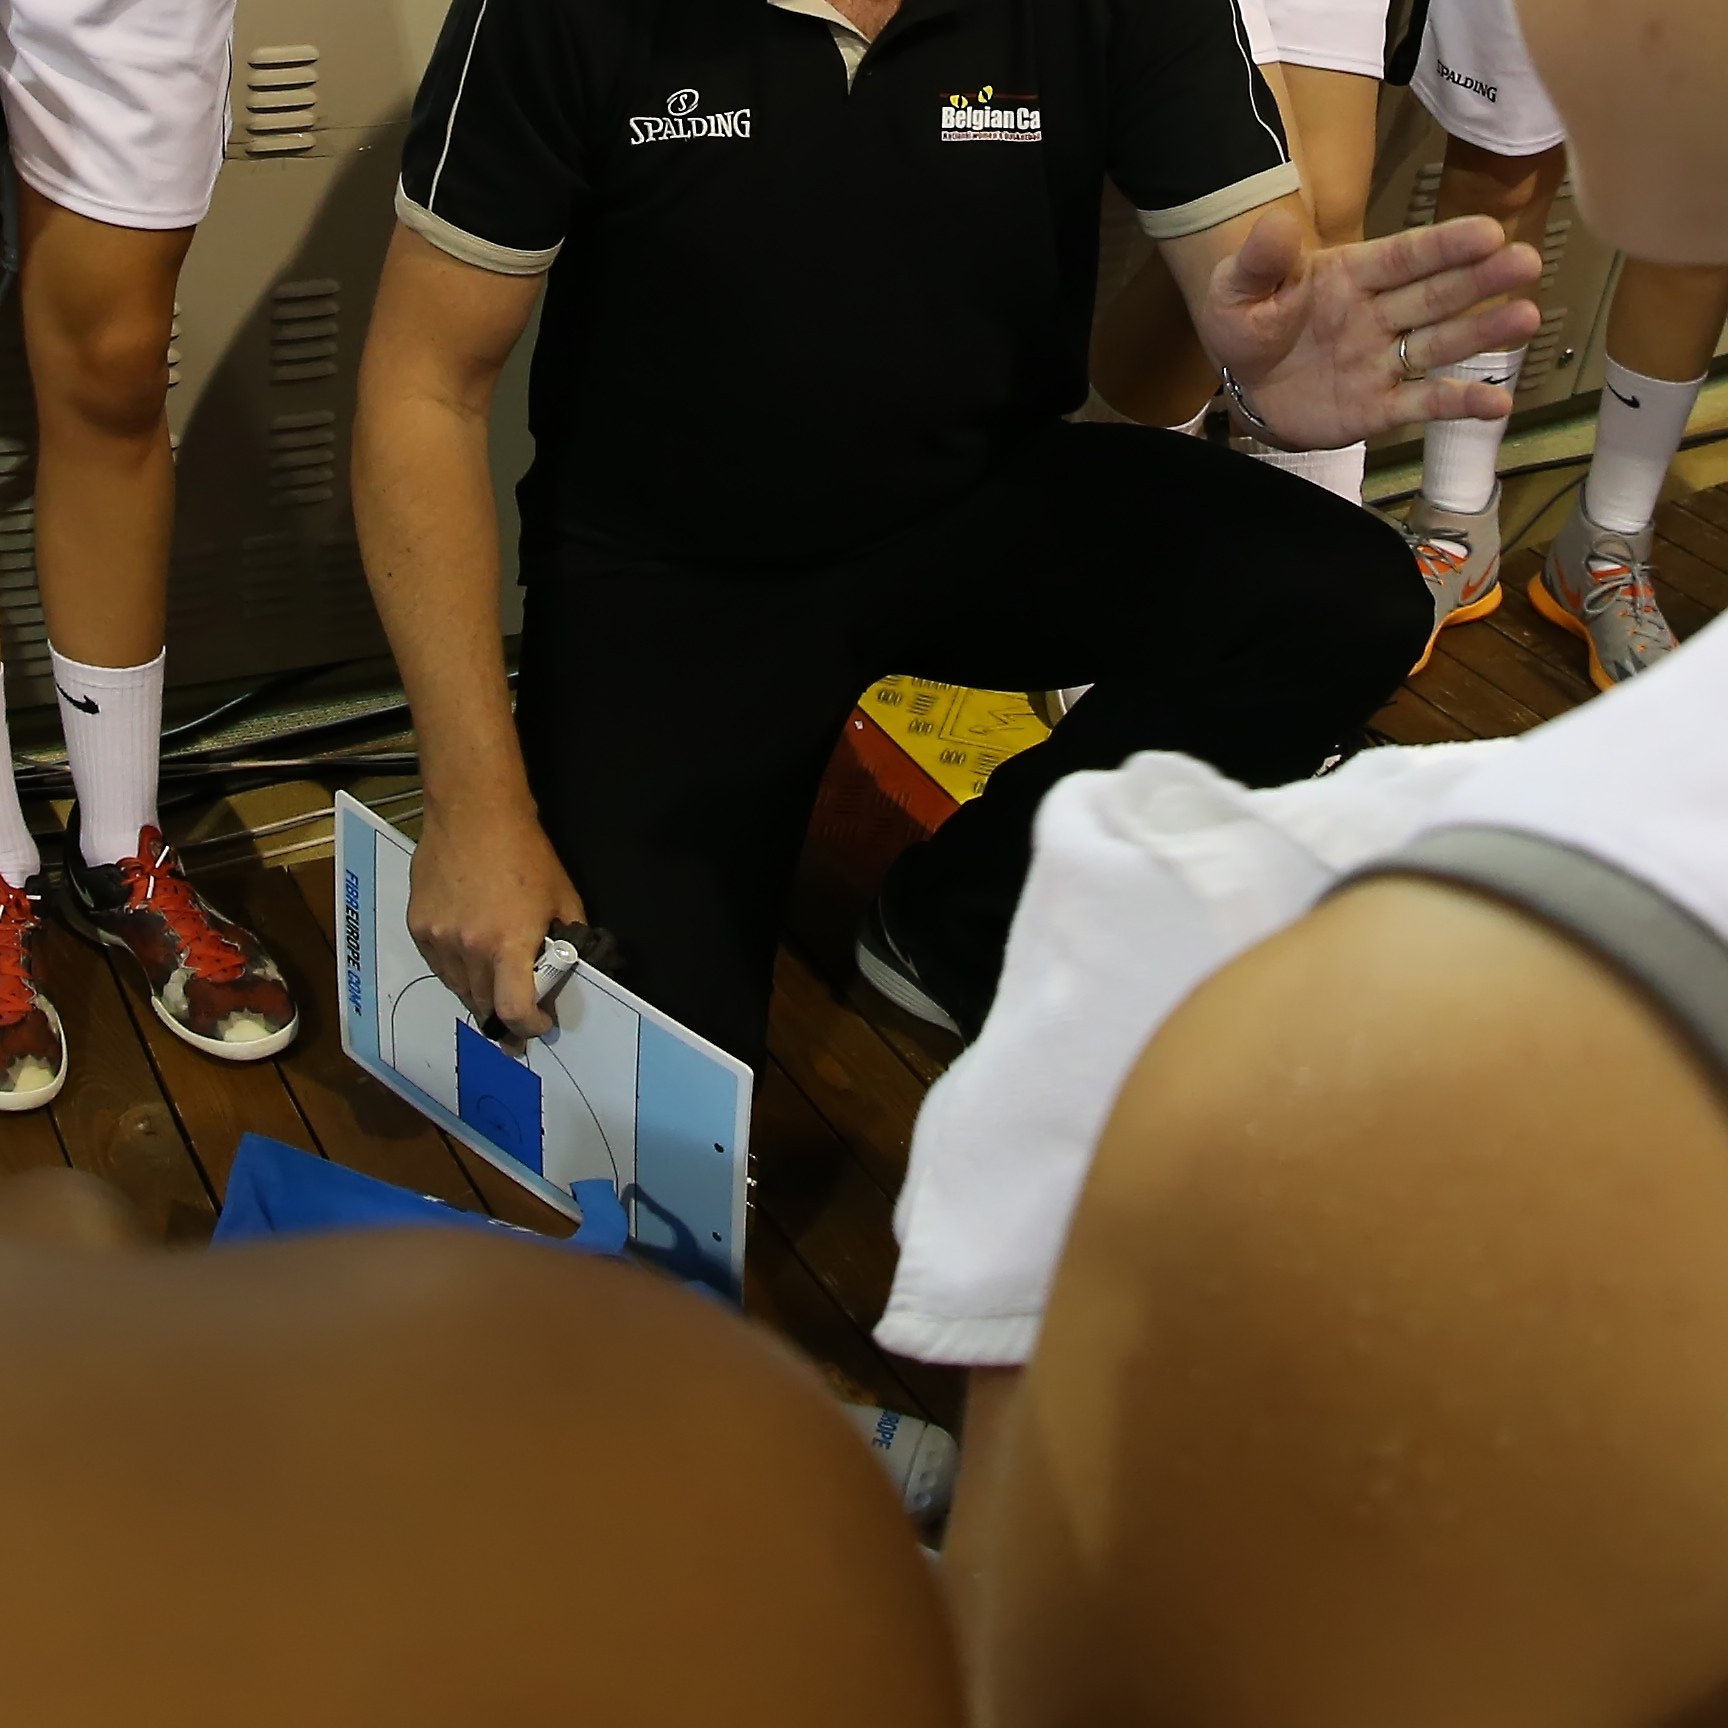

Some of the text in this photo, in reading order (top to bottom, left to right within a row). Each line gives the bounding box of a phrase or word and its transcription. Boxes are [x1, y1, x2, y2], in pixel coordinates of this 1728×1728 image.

[1437, 58, 1498, 103] SPALDING
[630, 108, 751, 145] SPALDING
[941, 105, 1015, 131] Belgian
[872, 1409, 901, 1451] ROPE
